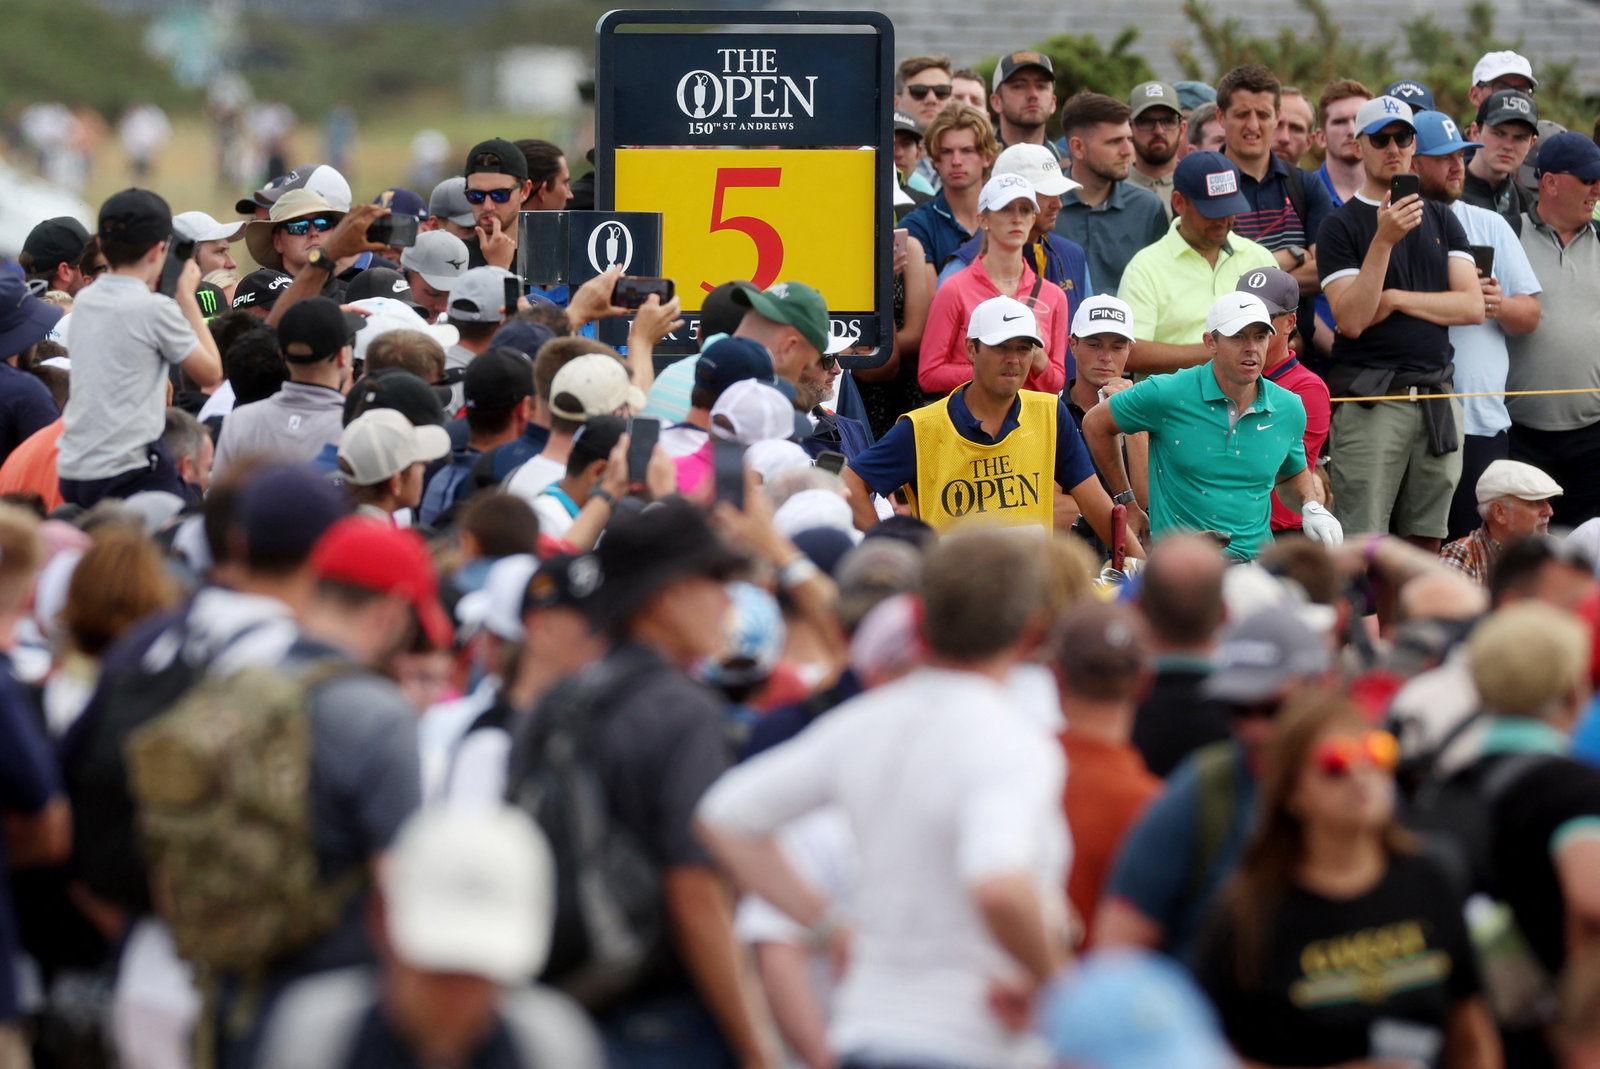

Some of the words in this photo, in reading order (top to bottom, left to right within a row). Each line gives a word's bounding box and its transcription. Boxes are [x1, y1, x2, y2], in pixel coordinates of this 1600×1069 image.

[717, 49, 778, 73] THE
[676, 69, 819, 119] OPEN
[1383, 98, 1400, 114] LA
[1502, 97, 1530, 114] 150
[722, 122, 737, 131] ST
[738, 122, 795, 131] ANDREWS
[1442, 120, 1457, 140] P
[1210, 182, 1228, 194] SHOT
[700, 168, 784, 293] 5
[232, 291, 256, 308] EPIC
[1091, 309, 1124, 322] PING
[970, 455, 1013, 479] THE
[941, 472, 1040, 518] OPEN
